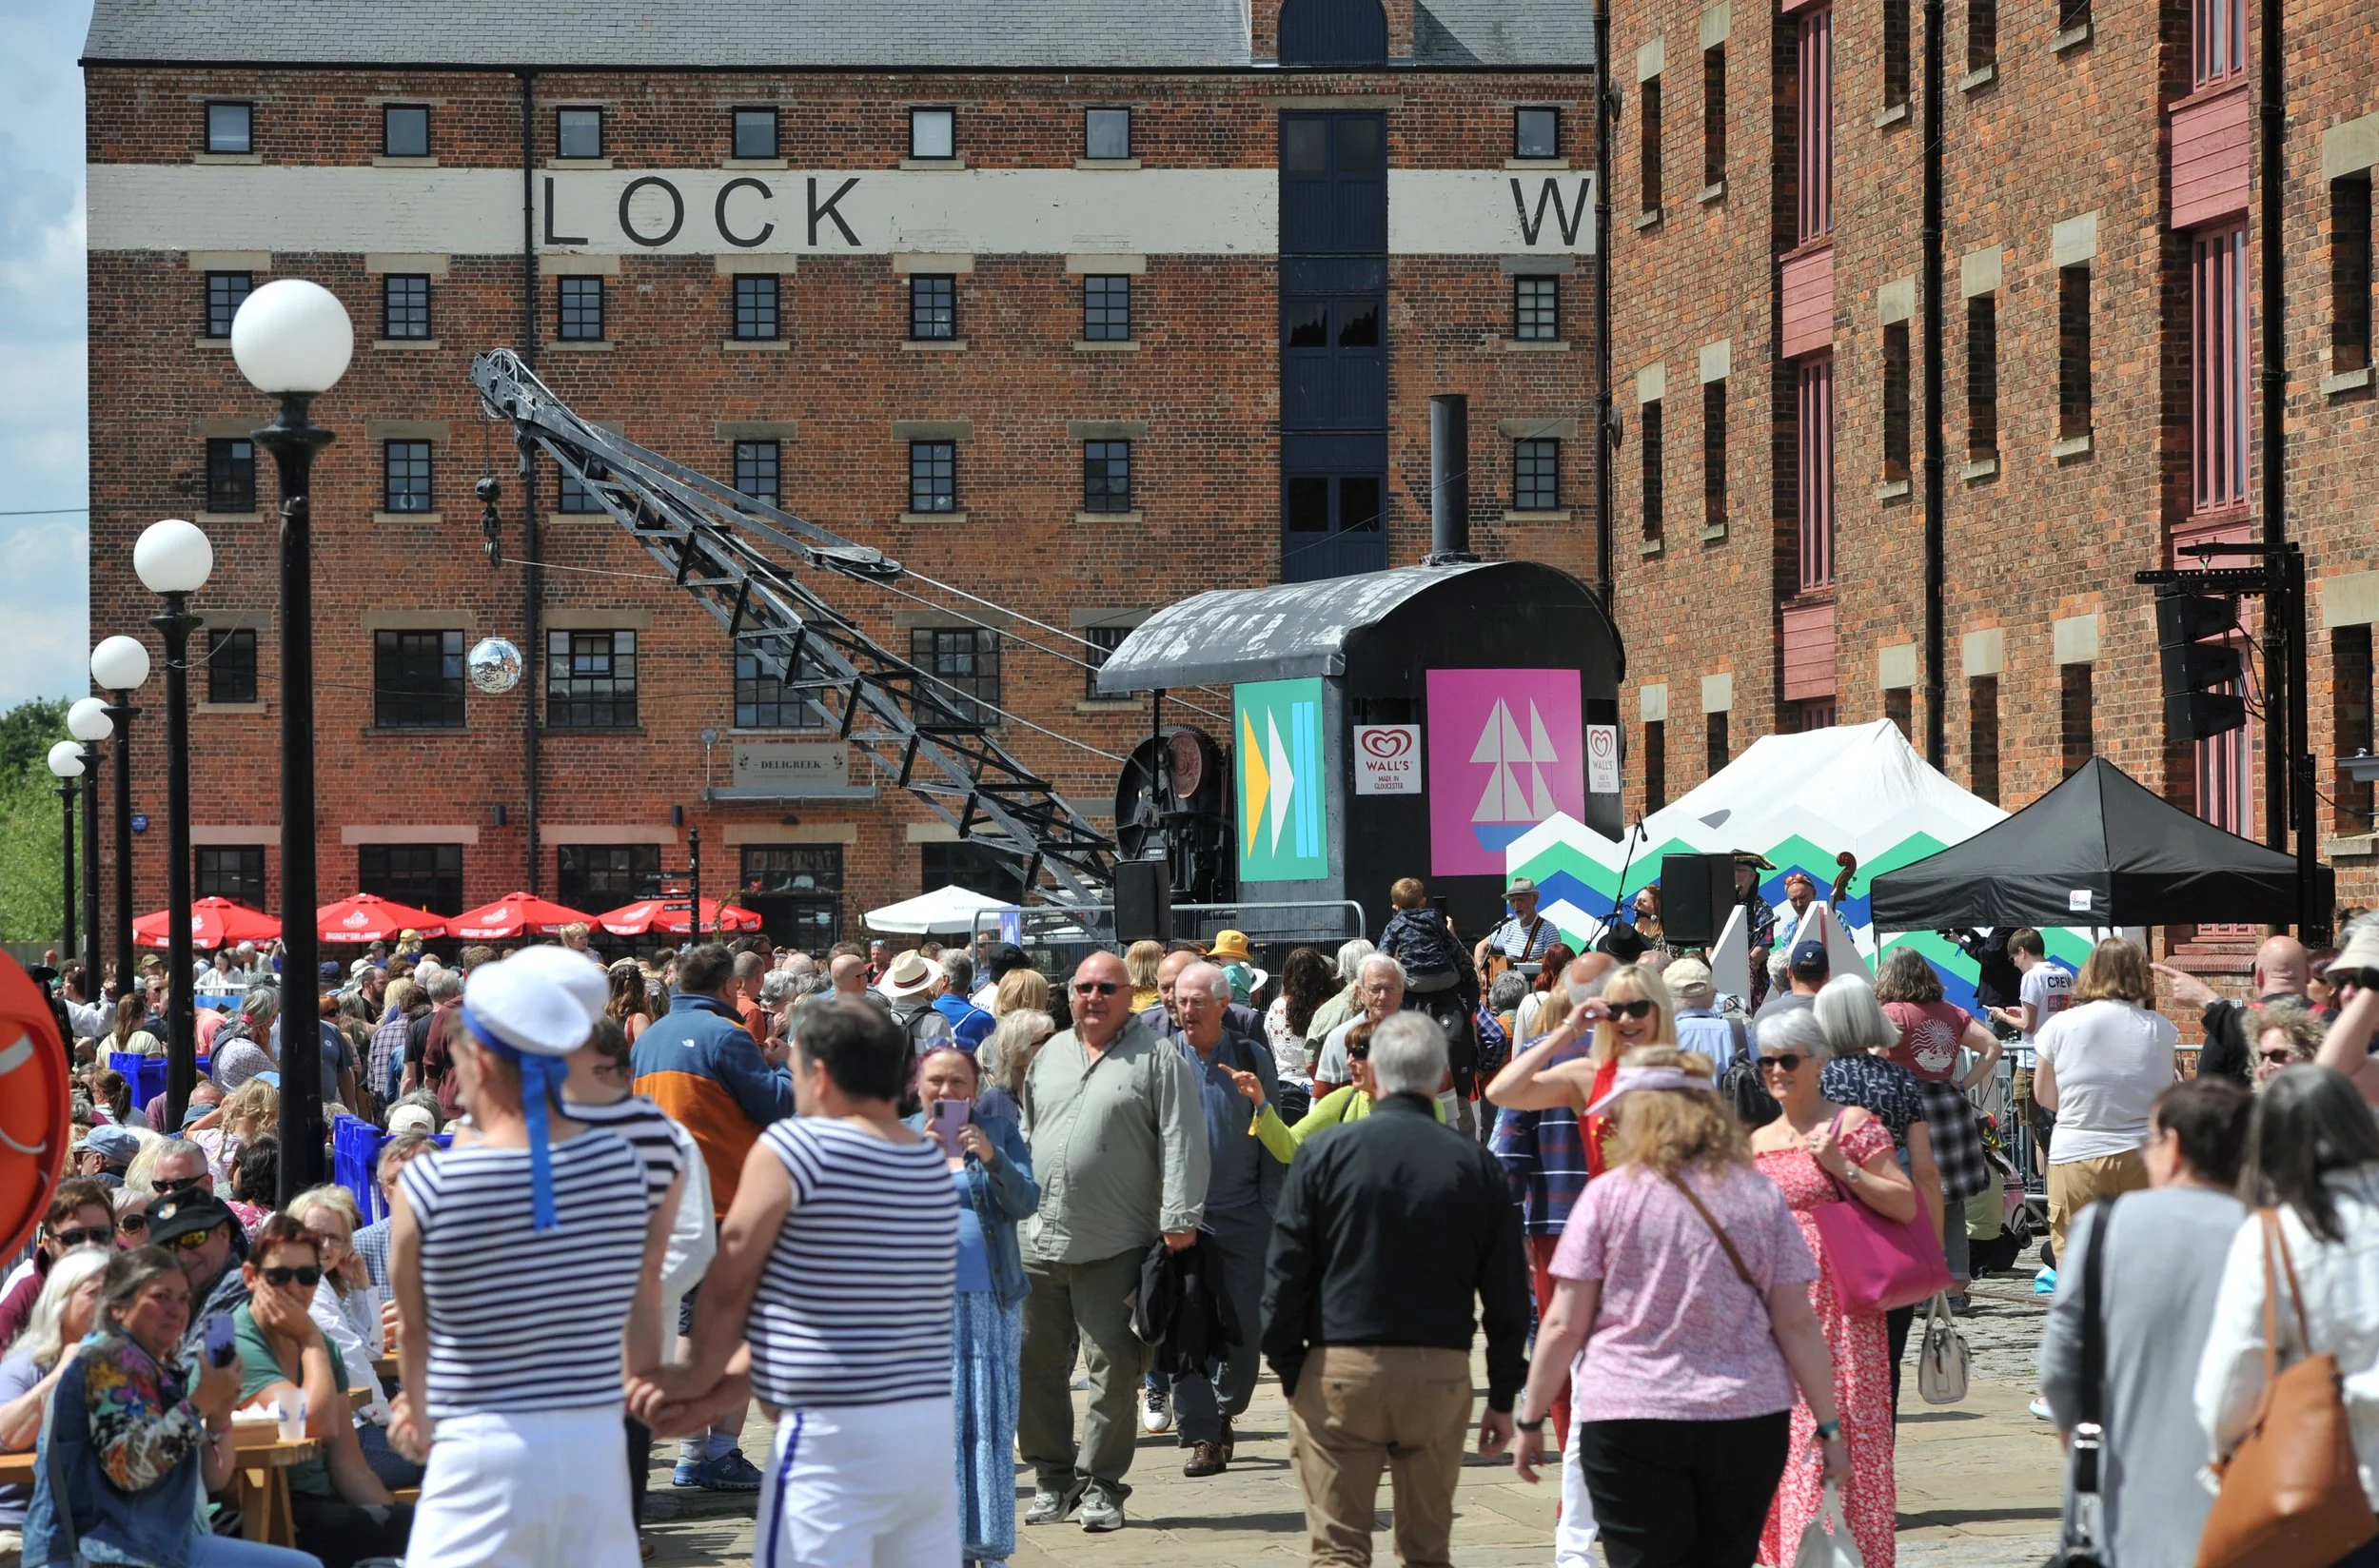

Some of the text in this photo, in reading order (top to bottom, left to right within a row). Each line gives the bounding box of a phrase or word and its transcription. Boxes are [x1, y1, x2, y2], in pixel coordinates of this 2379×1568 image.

[544, 176, 861, 247] LOCK
[761, 760, 821, 769] DELIGREEK
[1366, 760, 1409, 772] WALL'S
[2047, 976, 2073, 988] CREW
